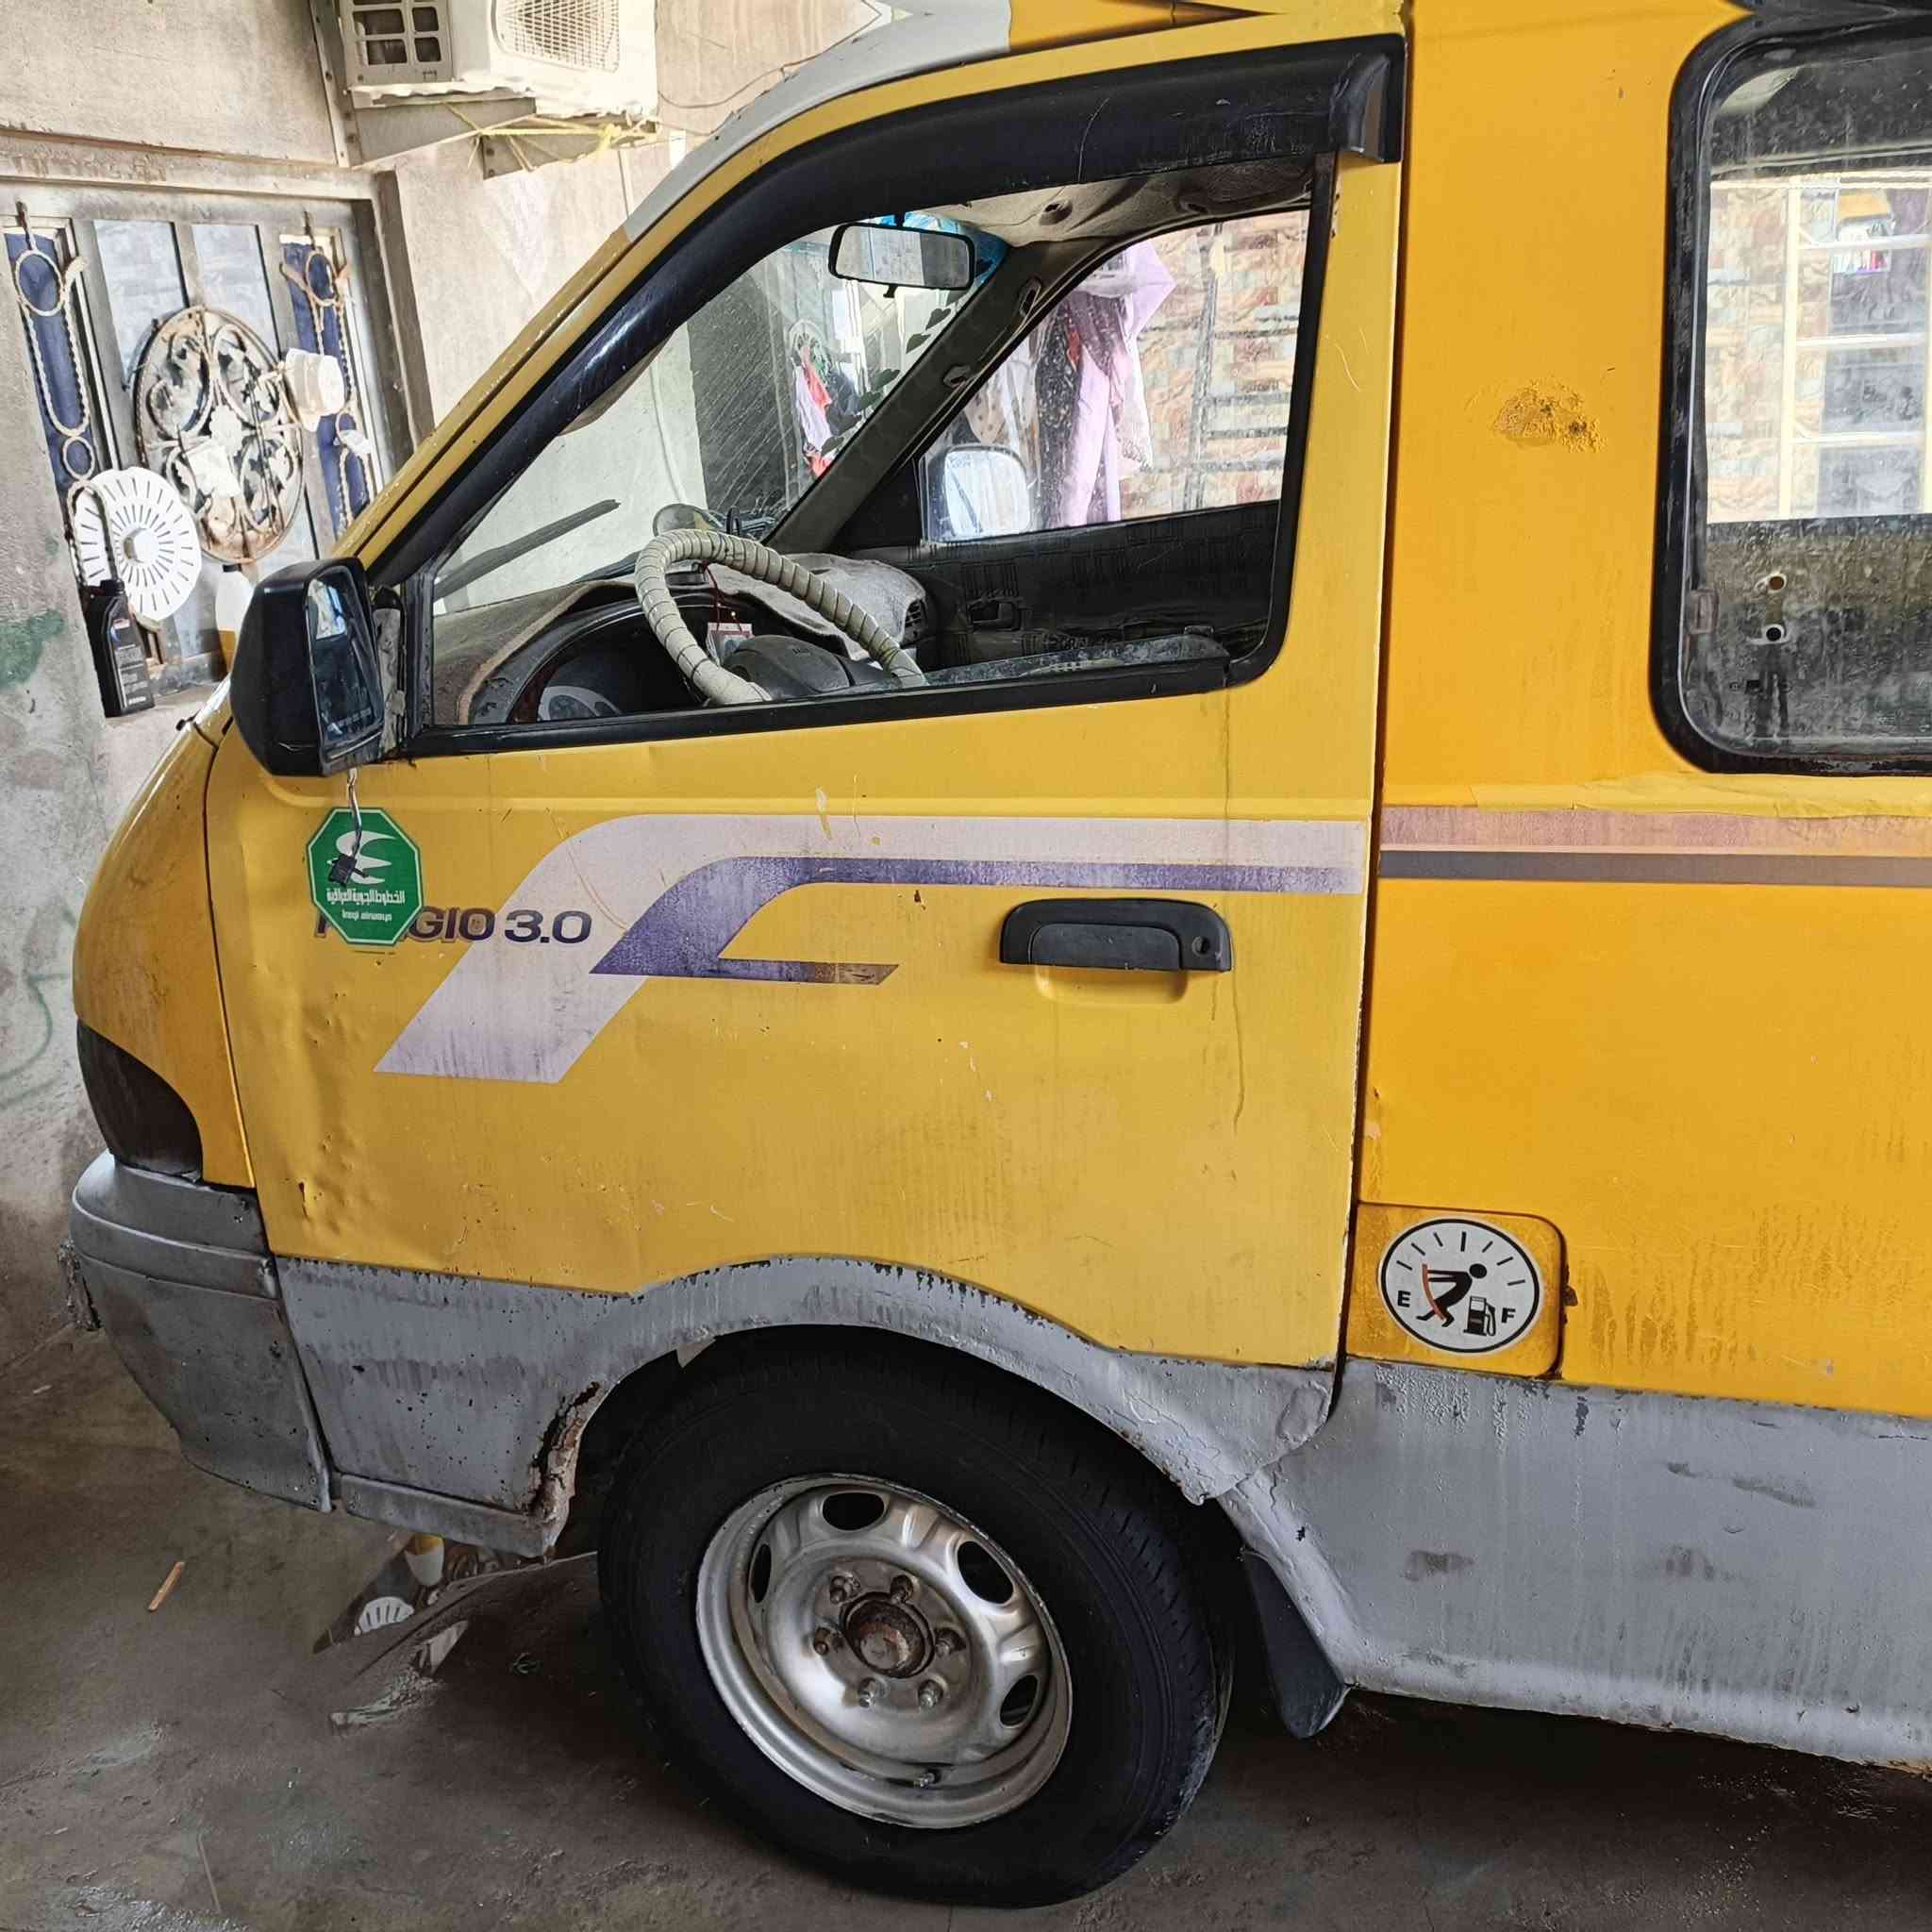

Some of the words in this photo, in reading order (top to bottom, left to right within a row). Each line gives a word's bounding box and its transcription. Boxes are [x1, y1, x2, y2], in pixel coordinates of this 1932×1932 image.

[504, 909, 592, 944] 3.0
[1397, 1290, 1411, 1307] E
[1501, 1307, 1516, 1324] F
